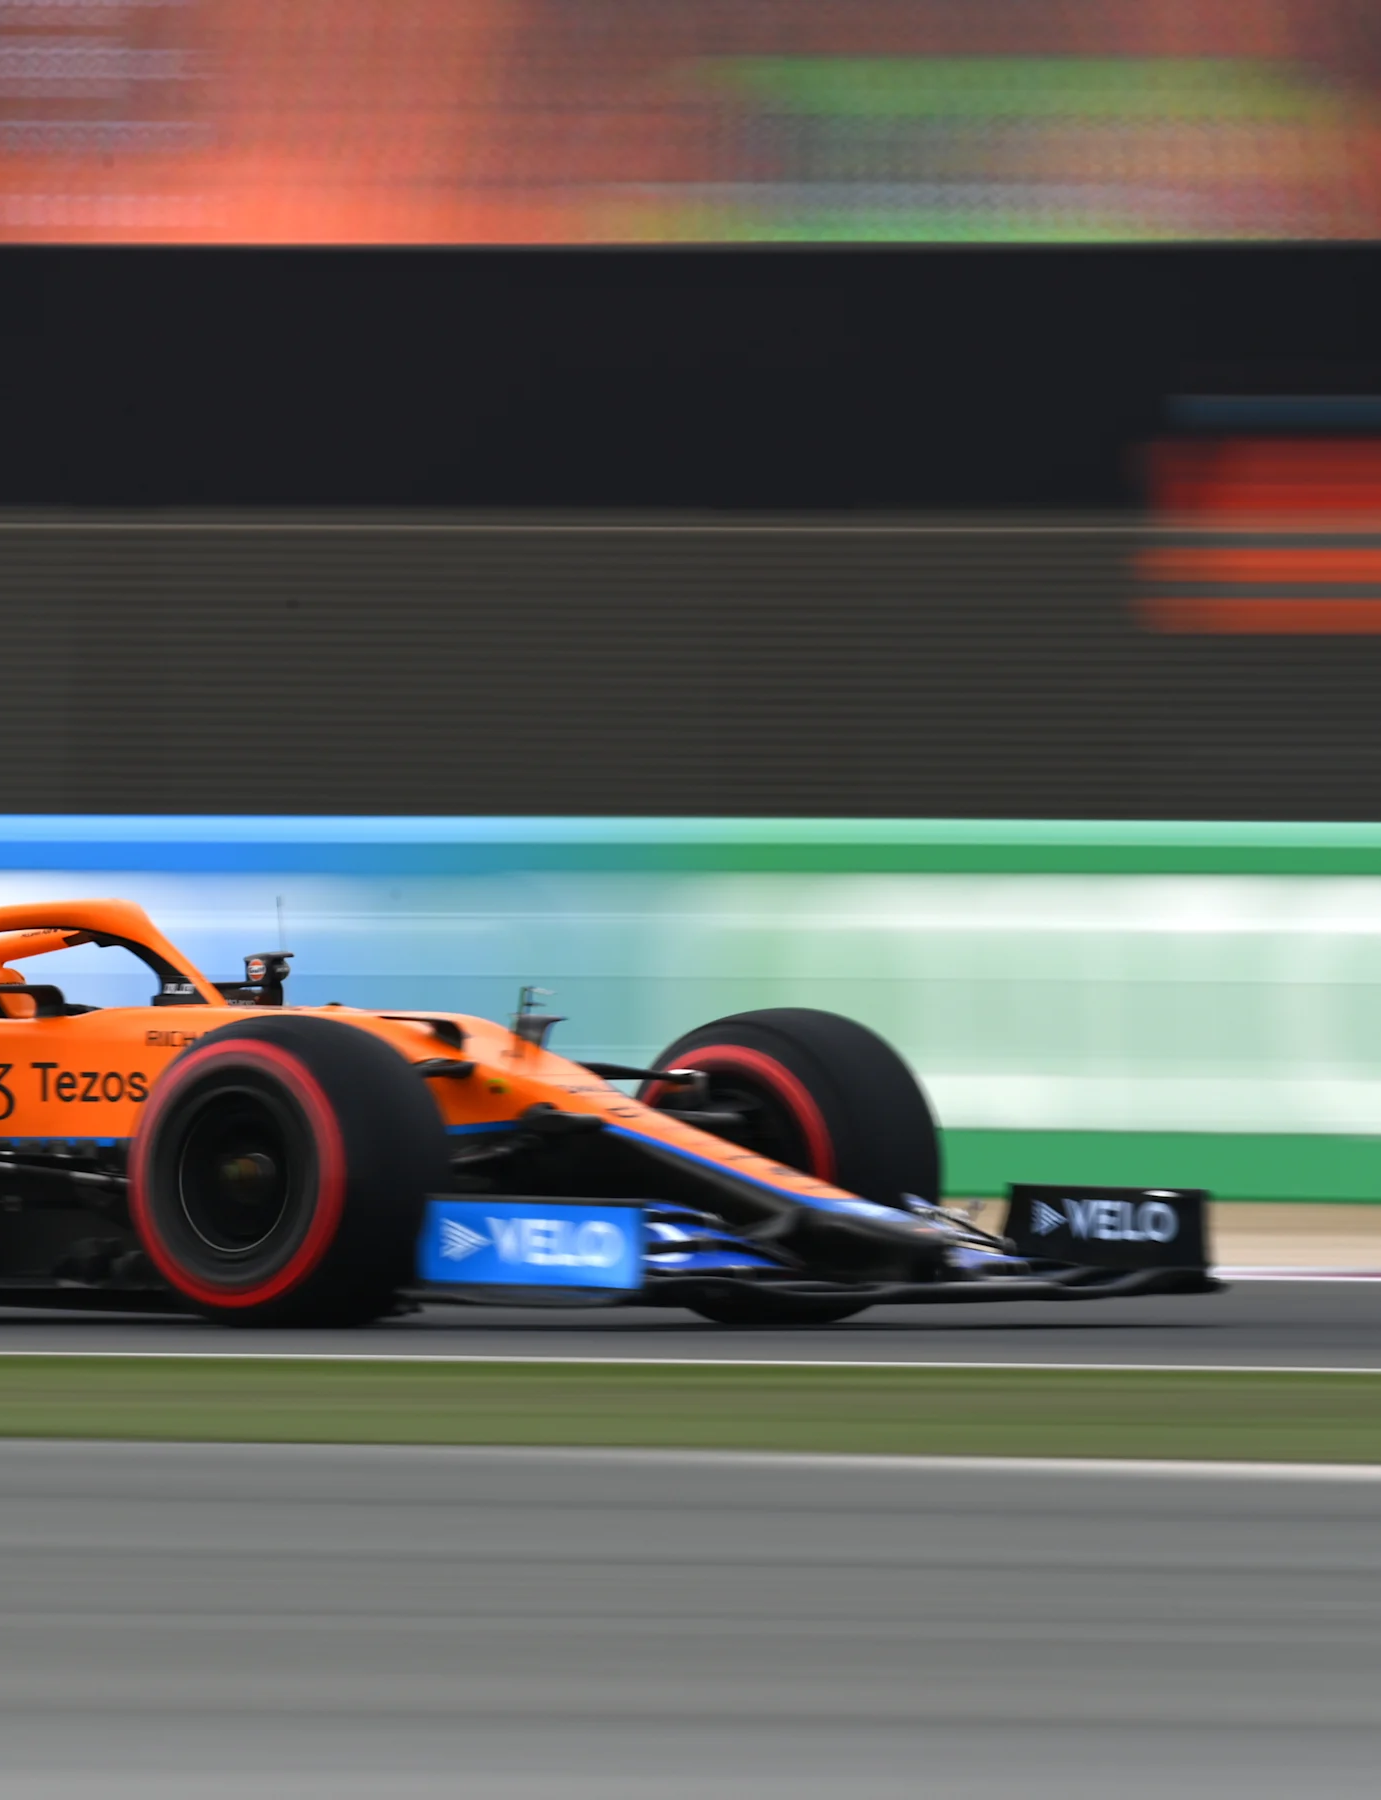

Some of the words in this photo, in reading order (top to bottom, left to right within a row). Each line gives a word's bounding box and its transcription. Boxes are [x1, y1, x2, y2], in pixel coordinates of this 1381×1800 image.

[145, 1030, 209, 1047] RICH
[30, 1061, 149, 1103] Tezos
[485, 1216, 625, 1268] VELO
[1060, 1198, 1180, 1244] VELO
